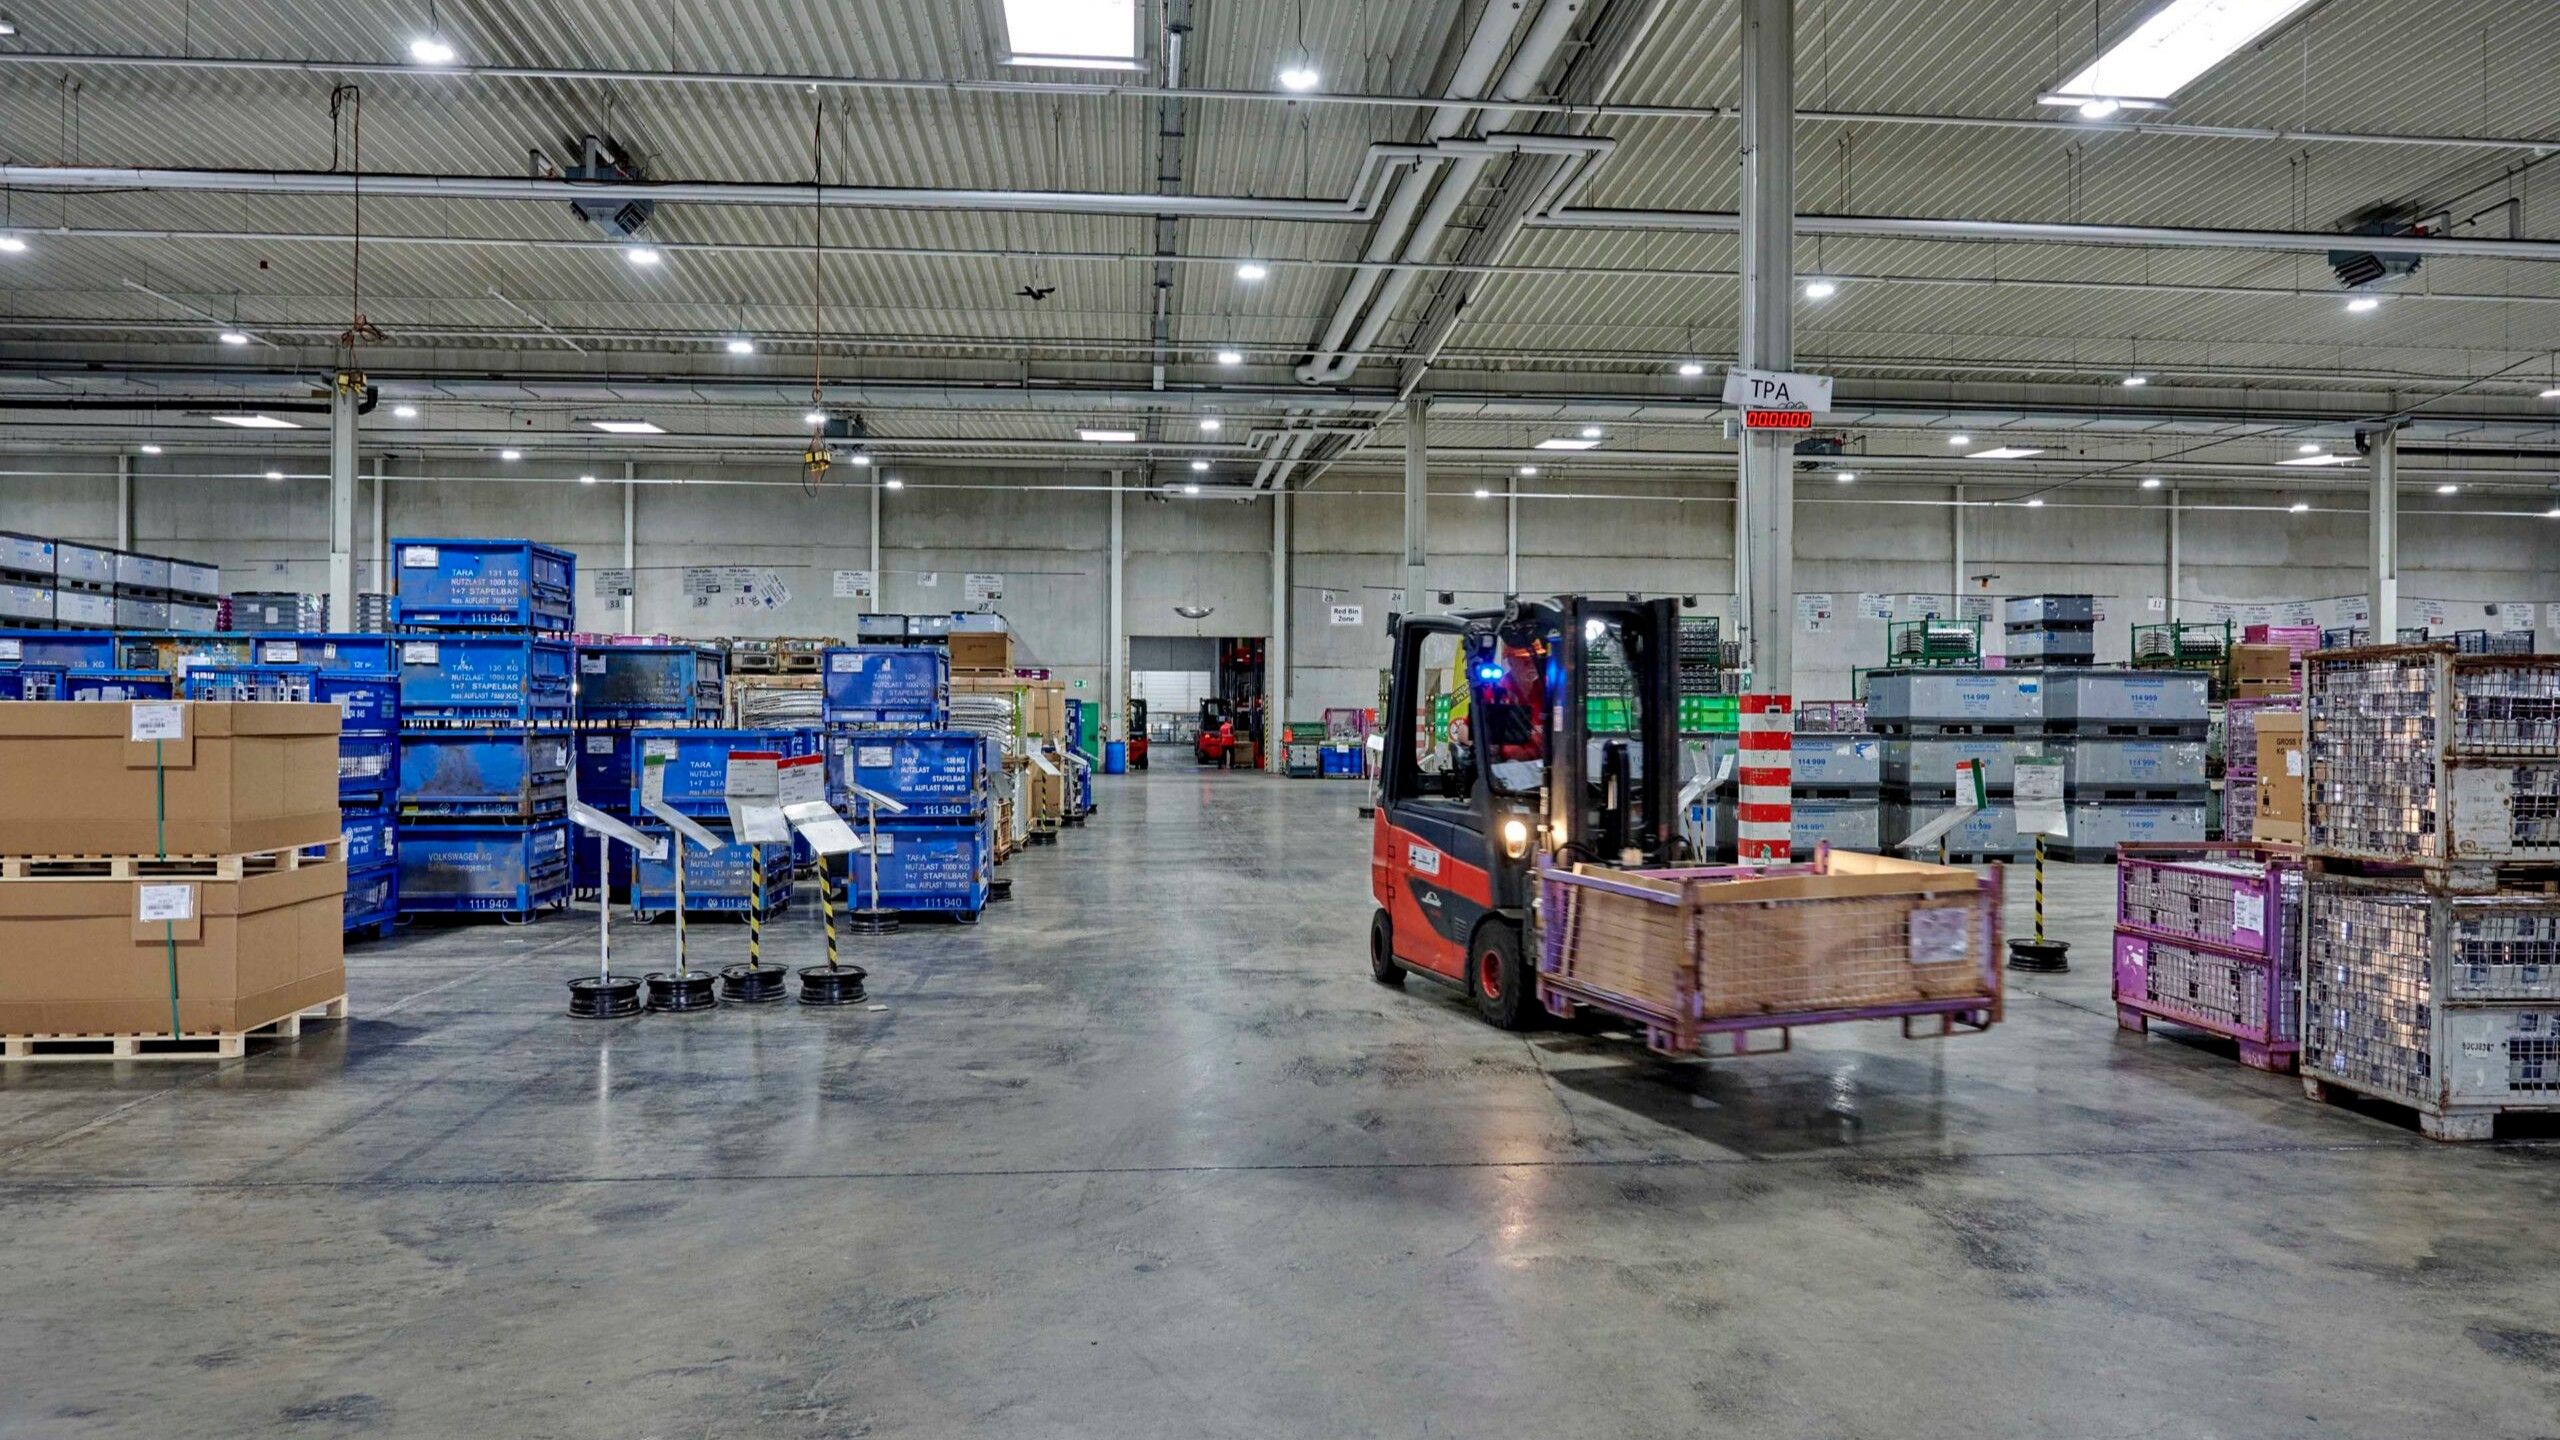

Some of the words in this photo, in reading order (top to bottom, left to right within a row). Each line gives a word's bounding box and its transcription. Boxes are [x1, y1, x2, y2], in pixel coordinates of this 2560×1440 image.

[1750, 378, 1790, 401] TPA
[451, 578, 485, 586] NUTZLAST
[489, 578, 506, 586] 1000
[507, 578, 519, 586] KG
[464, 597, 489, 605] AUFLAST
[507, 597, 519, 605] KG
[609, 600, 620, 608] 33
[697, 597, 708, 605] 32
[735, 597, 745, 605] 31
[471, 613, 487, 623] 111
[490, 613, 510, 623] 940
[92, 660, 105, 668] KG
[464, 692, 489, 700] AUFLAST
[506, 692, 518, 700] KG
[1976, 693, 1990, 701] 999
[471, 708, 487, 718] 111
[490, 708, 510, 718] 940
[2276, 747, 2285, 755] KG
[932, 775, 966, 783] STAPELBAR
[923, 805, 939, 814] 111
[941, 805, 962, 814] 940
[428, 852, 479, 861] VOLKSWAGEN
[481, 852, 492, 861] AG
[469, 899, 486, 909] 111
[489, 899, 509, 909] 940
[720, 898, 735, 908] 111
[924, 898, 941, 908] 111
[943, 898, 962, 908] 940
